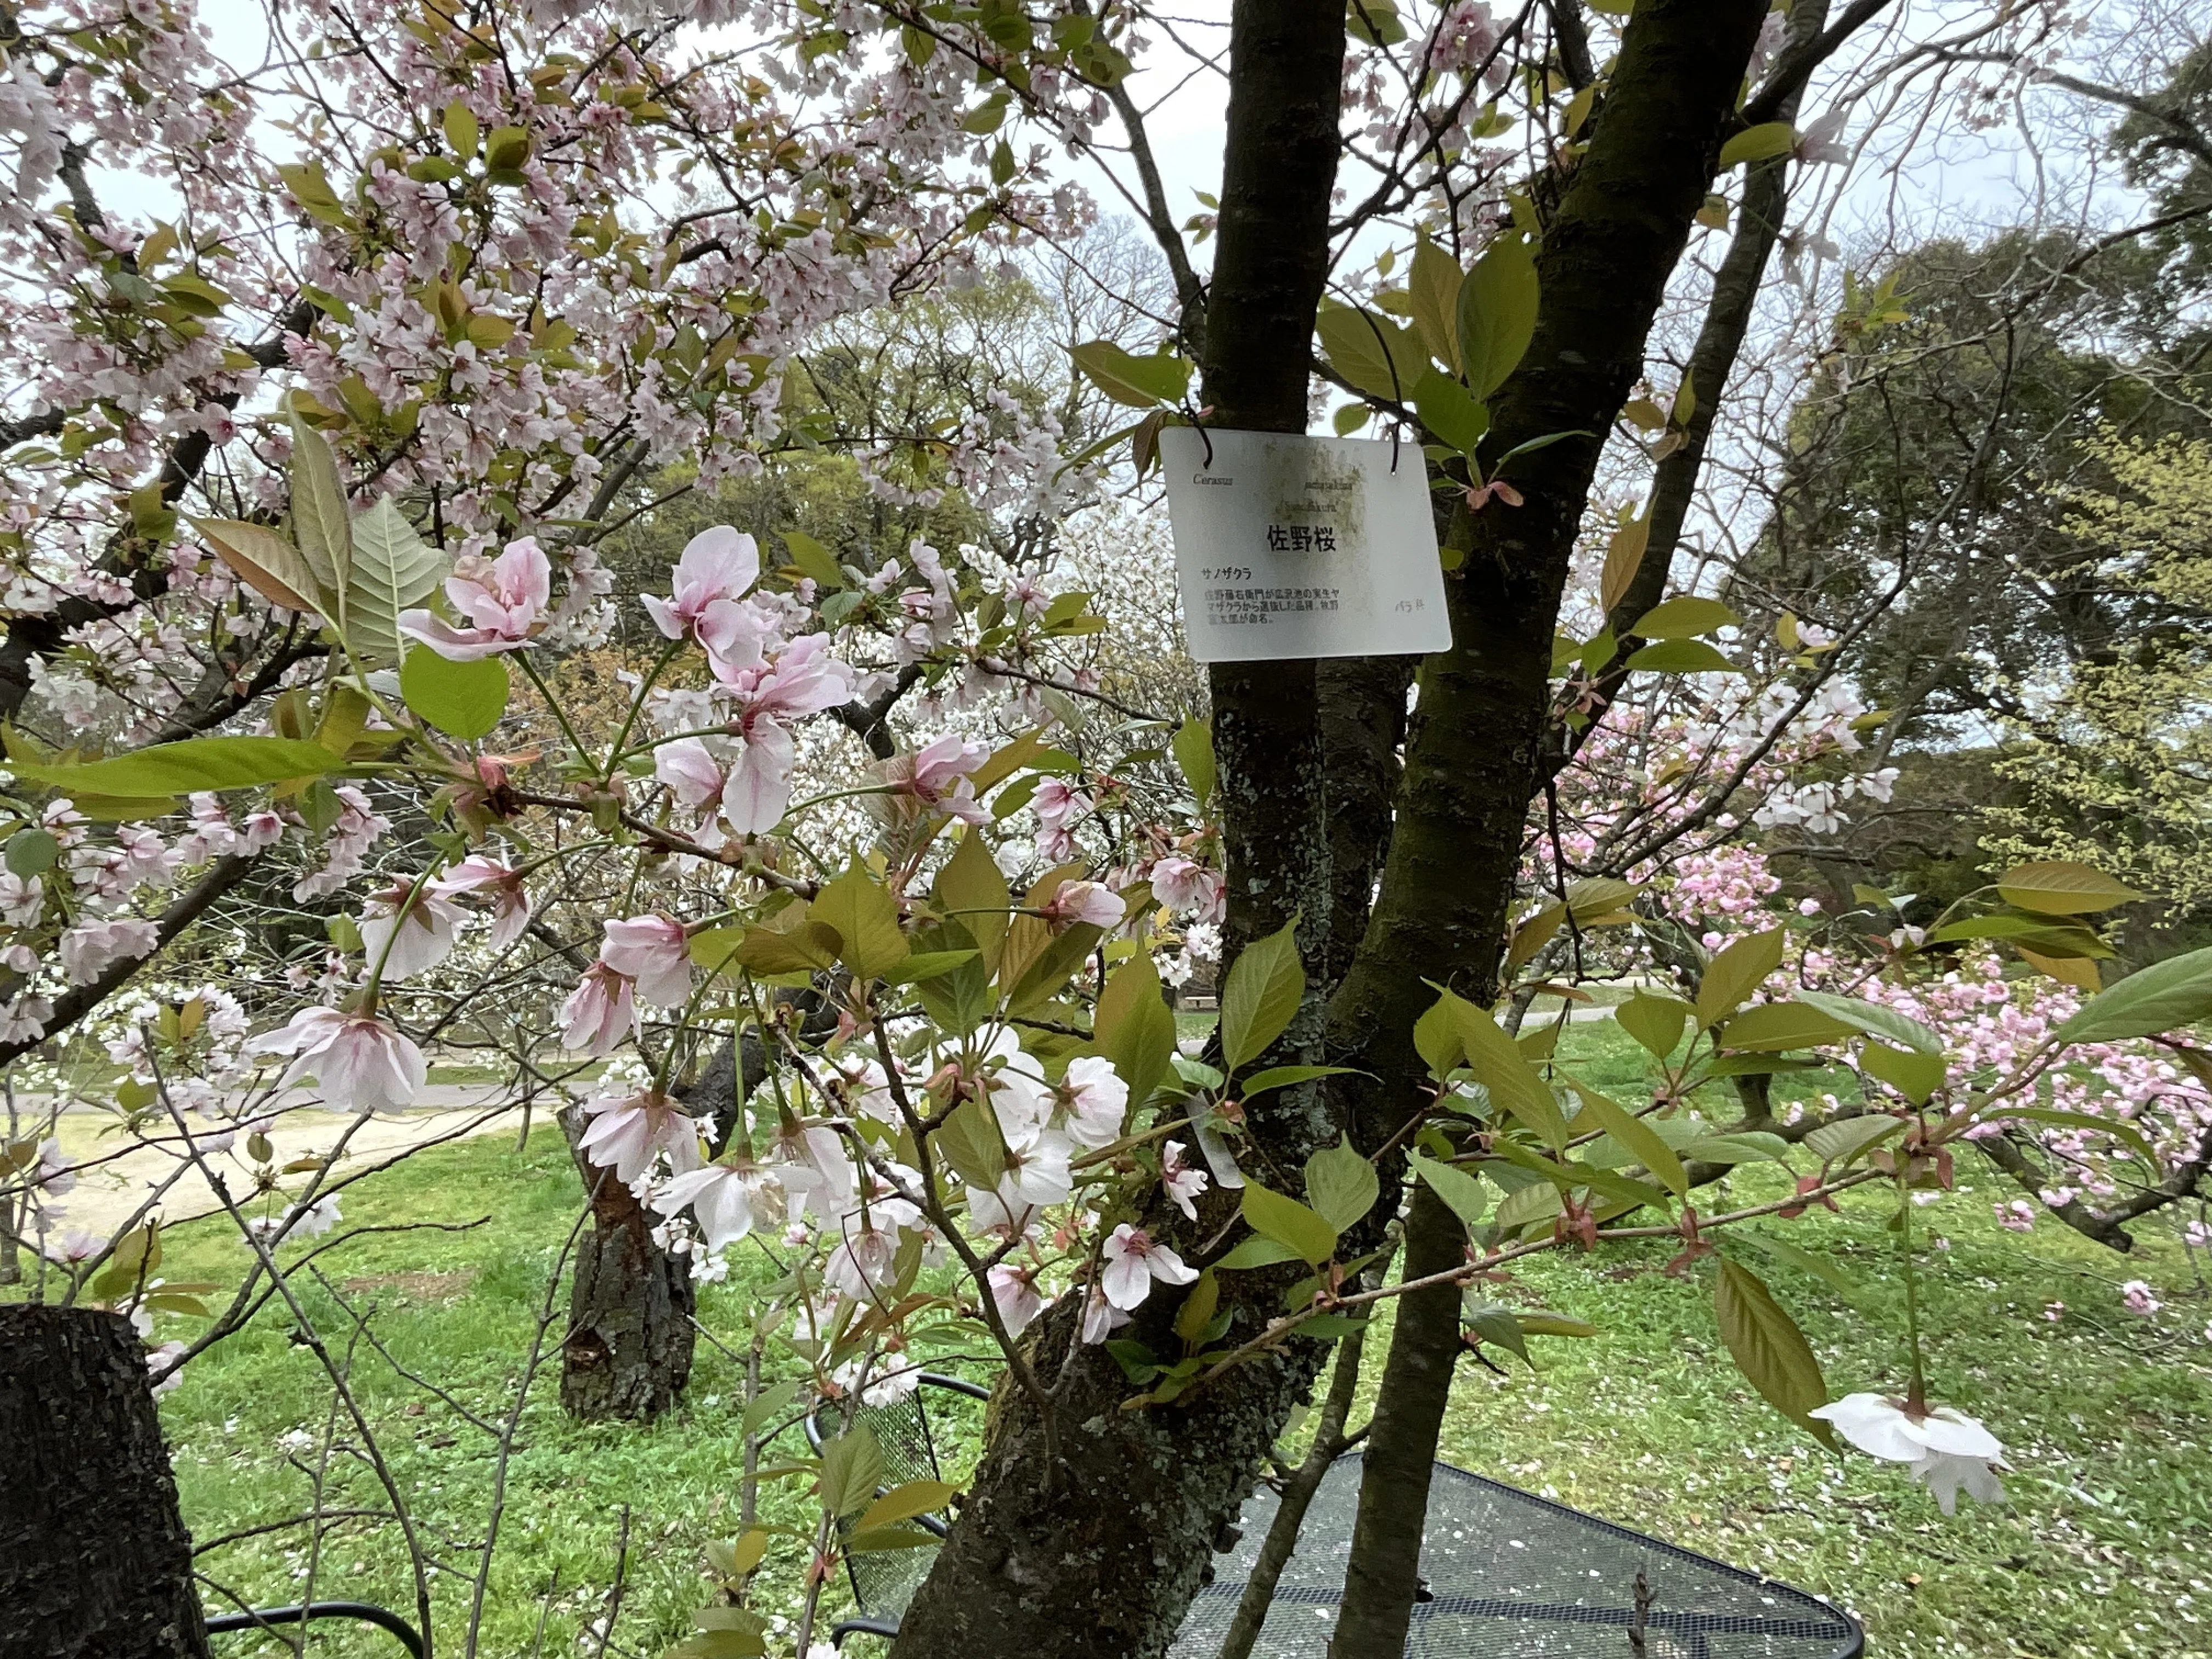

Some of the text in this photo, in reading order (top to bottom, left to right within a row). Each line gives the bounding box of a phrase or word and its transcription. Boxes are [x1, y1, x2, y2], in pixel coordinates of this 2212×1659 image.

[1267, 524, 1336, 552] 佐野桜
[1201, 566, 1252, 580] サノザクラ
